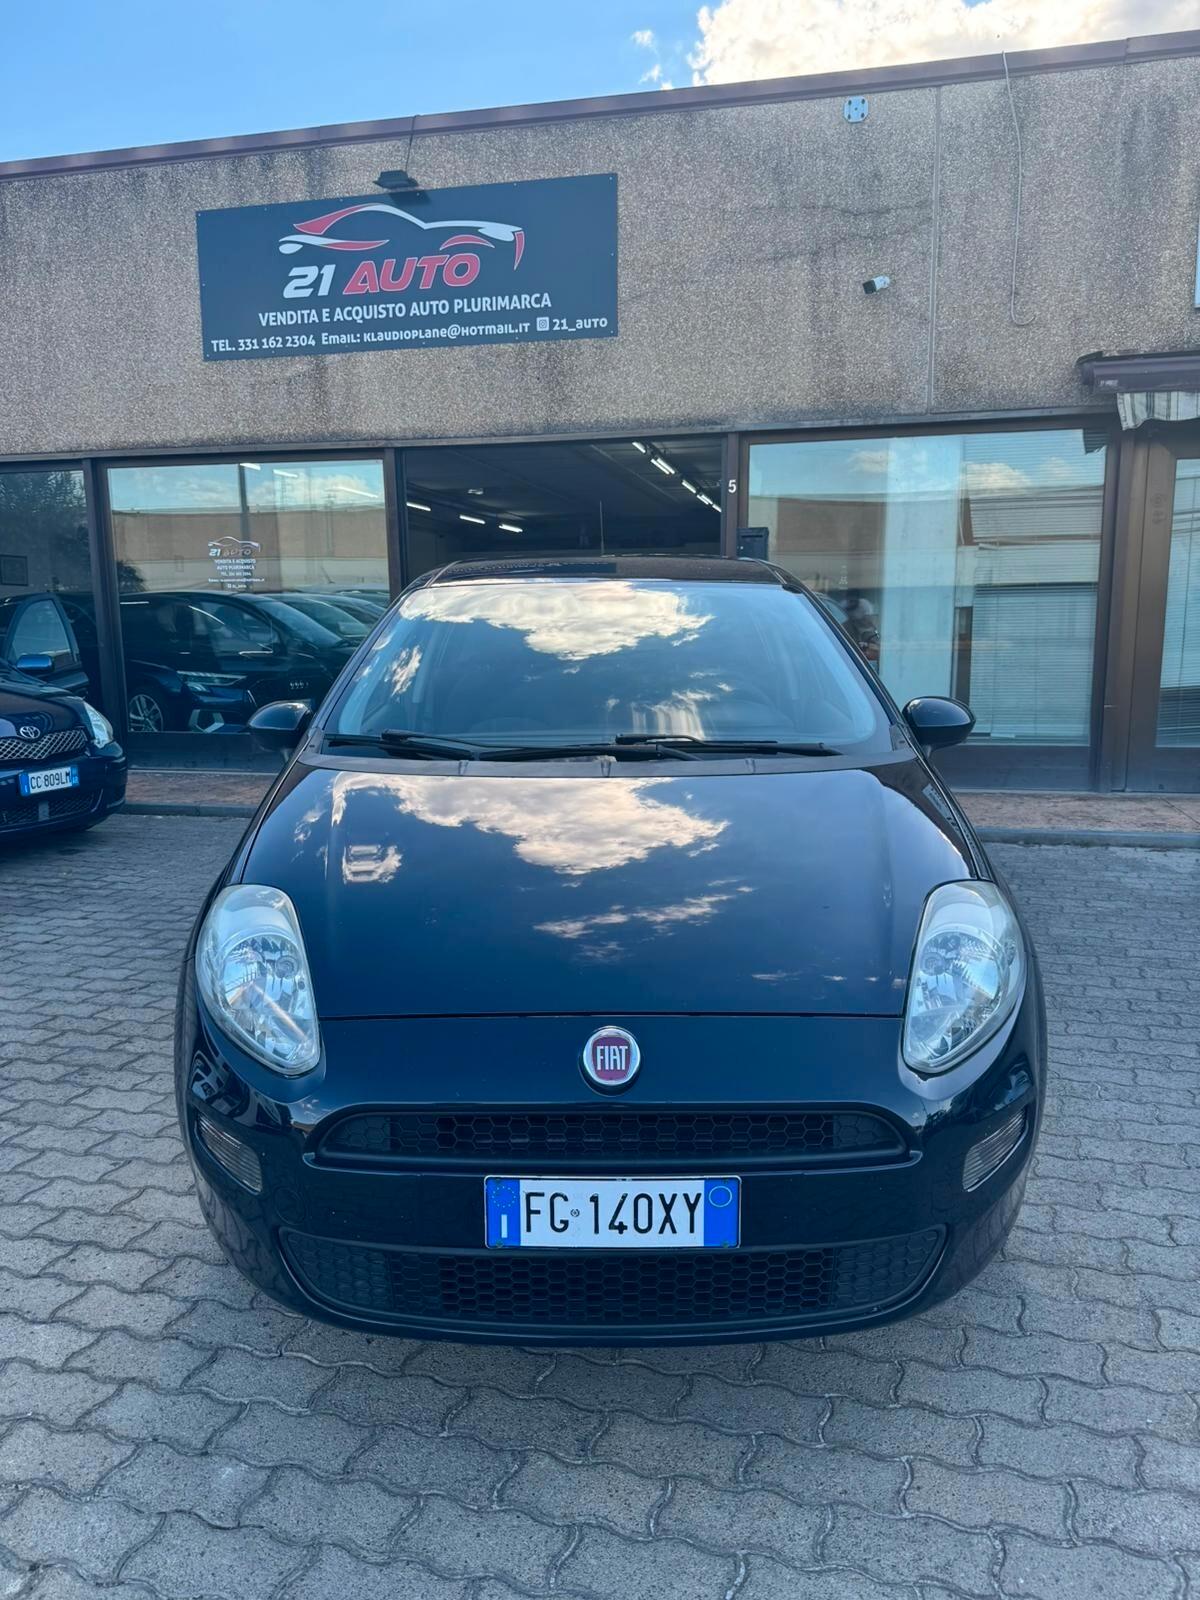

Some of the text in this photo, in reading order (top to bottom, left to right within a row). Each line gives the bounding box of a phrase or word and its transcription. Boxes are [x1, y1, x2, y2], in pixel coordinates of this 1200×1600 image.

[283, 253, 481, 299] 21 AUTO
[258, 292, 552, 327] VENDITA E ACQUISTO AUTO PLURIMARCA
[211, 339, 236, 352] TEL.
[238, 337, 259, 351] 331
[262, 336, 283, 349] 162
[285, 334, 316, 347] 2304
[728, 479, 737, 494] 5
[209, 548, 221, 557] 21
[30, 776, 42, 790] CC
[44, 771, 72, 787] 809LM
[596, 1045, 629, 1071] FIAT
[525, 1191, 569, 1234] FG
[589, 1192, 702, 1235] 140XY
